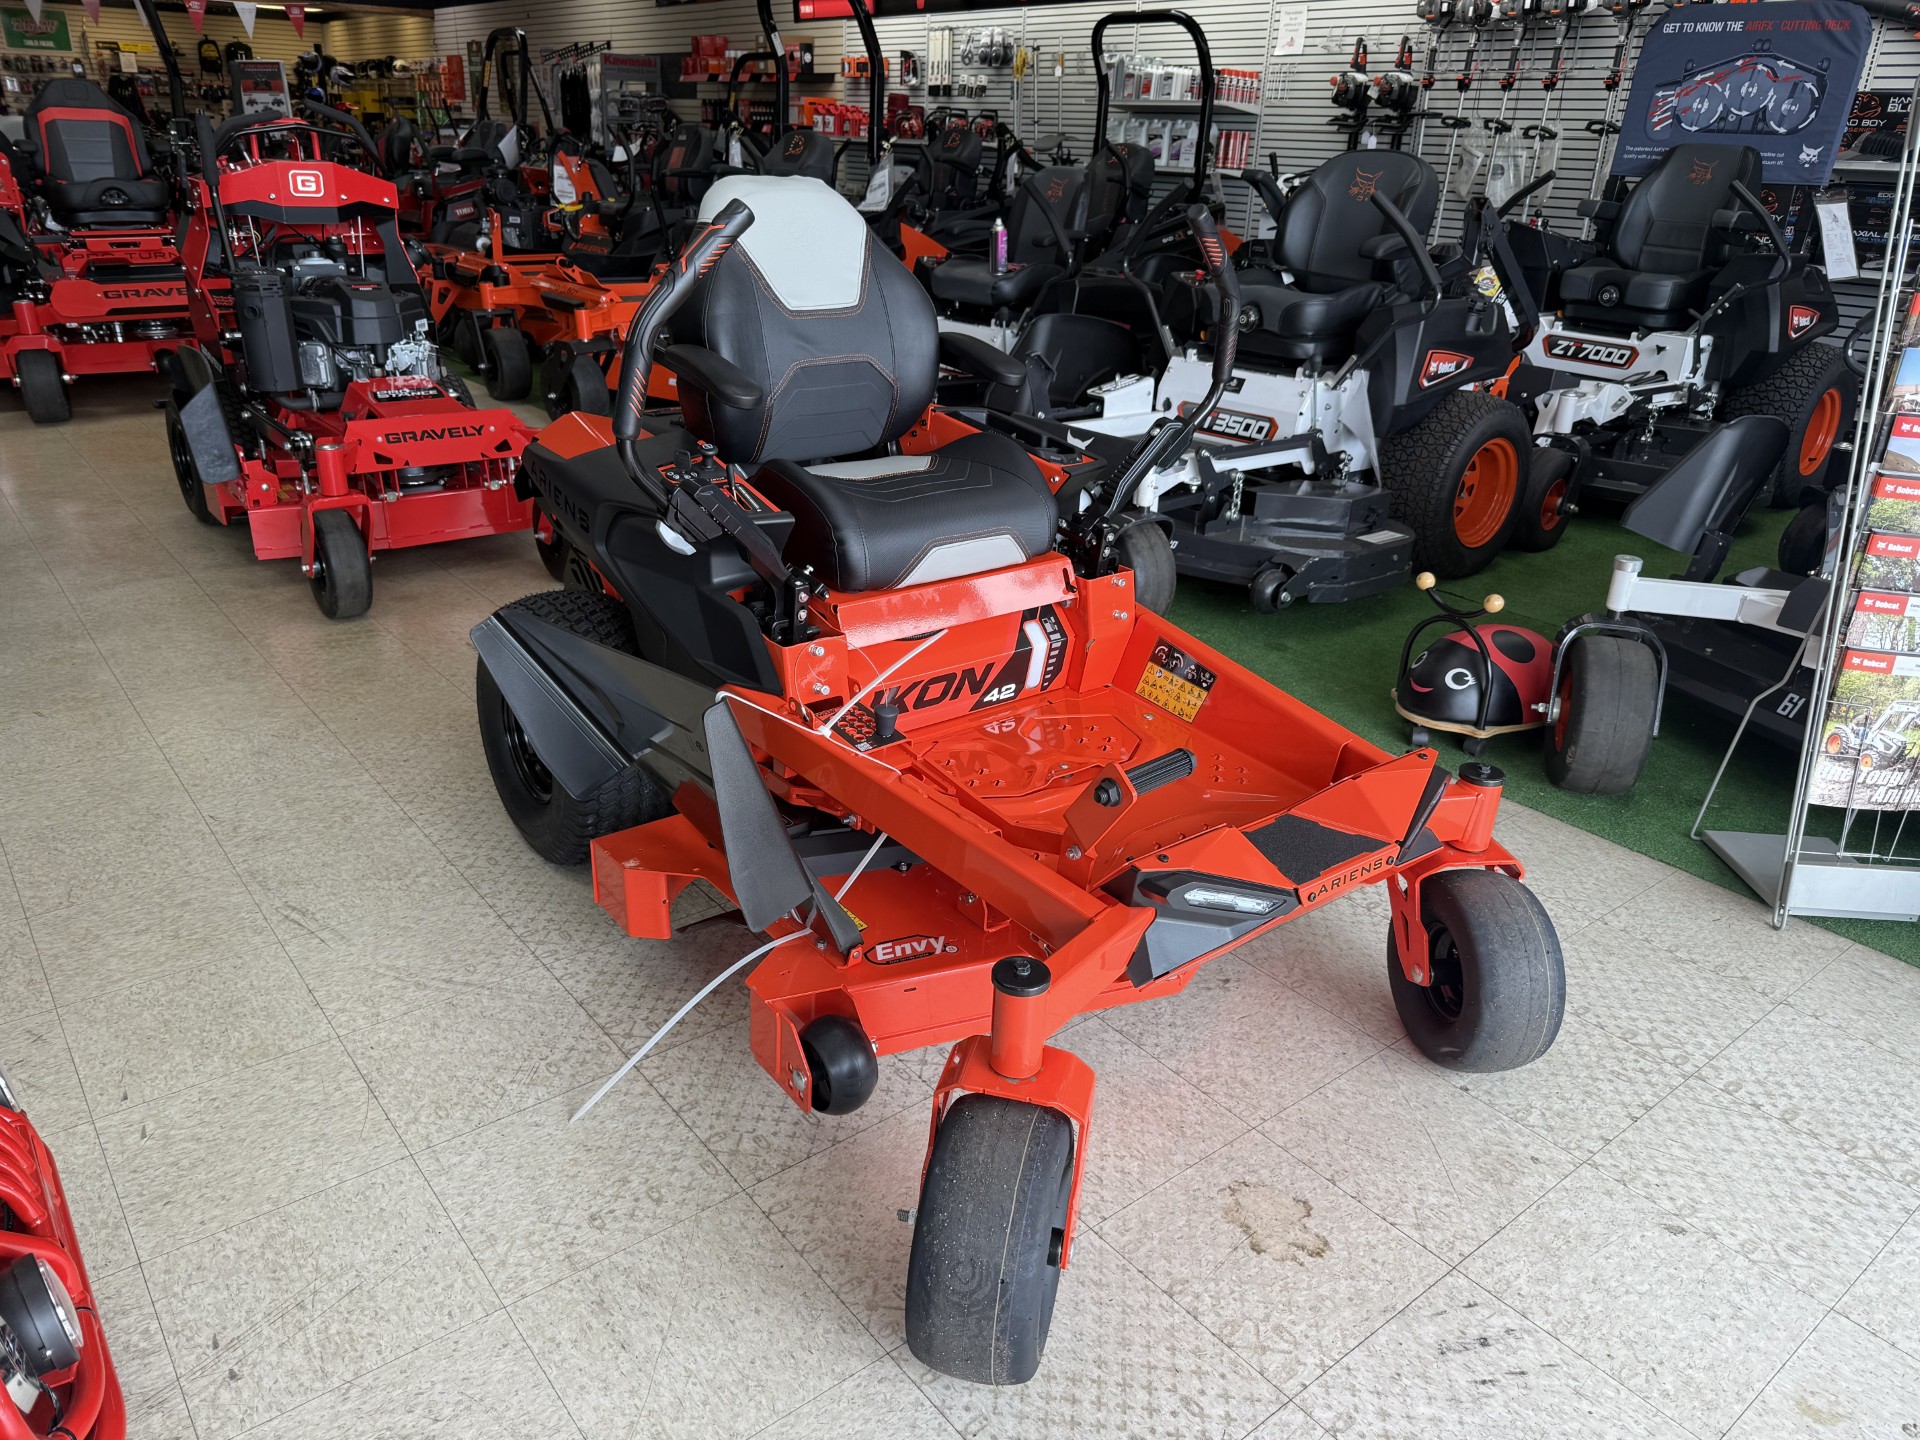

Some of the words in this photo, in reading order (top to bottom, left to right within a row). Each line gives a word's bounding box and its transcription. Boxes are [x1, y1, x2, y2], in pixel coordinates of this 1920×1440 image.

[1663, 23, 1681, 34] GET
[1683, 22, 1694, 32] TO
[1695, 21, 1723, 32] KNOW
[1726, 21, 1744, 31] THE
[1780, 19, 1822, 31] CUTTING
[1825, 19, 1851, 30] DECK
[1861, 119, 1887, 127] BOY
[455, 207, 474, 216] TORO
[102, 286, 188, 299] GRAVE
[1551, 340, 1631, 365] ZT7000
[1438, 360, 1457, 374] Bobcat
[385, 424, 485, 445] GRAVELY
[530, 460, 591, 535] ARIENS
[1887, 543, 1913, 553] Bobcat
[1875, 600, 1901, 610] Bobcat
[1862, 659, 1888, 669] Bobcat
[870, 661, 996, 714] IKON
[983, 683, 1016, 703] 42
[1776, 691, 1807, 720] 61
[1317, 858, 1383, 897] ARIENS
[875, 935, 945, 961] Envy
